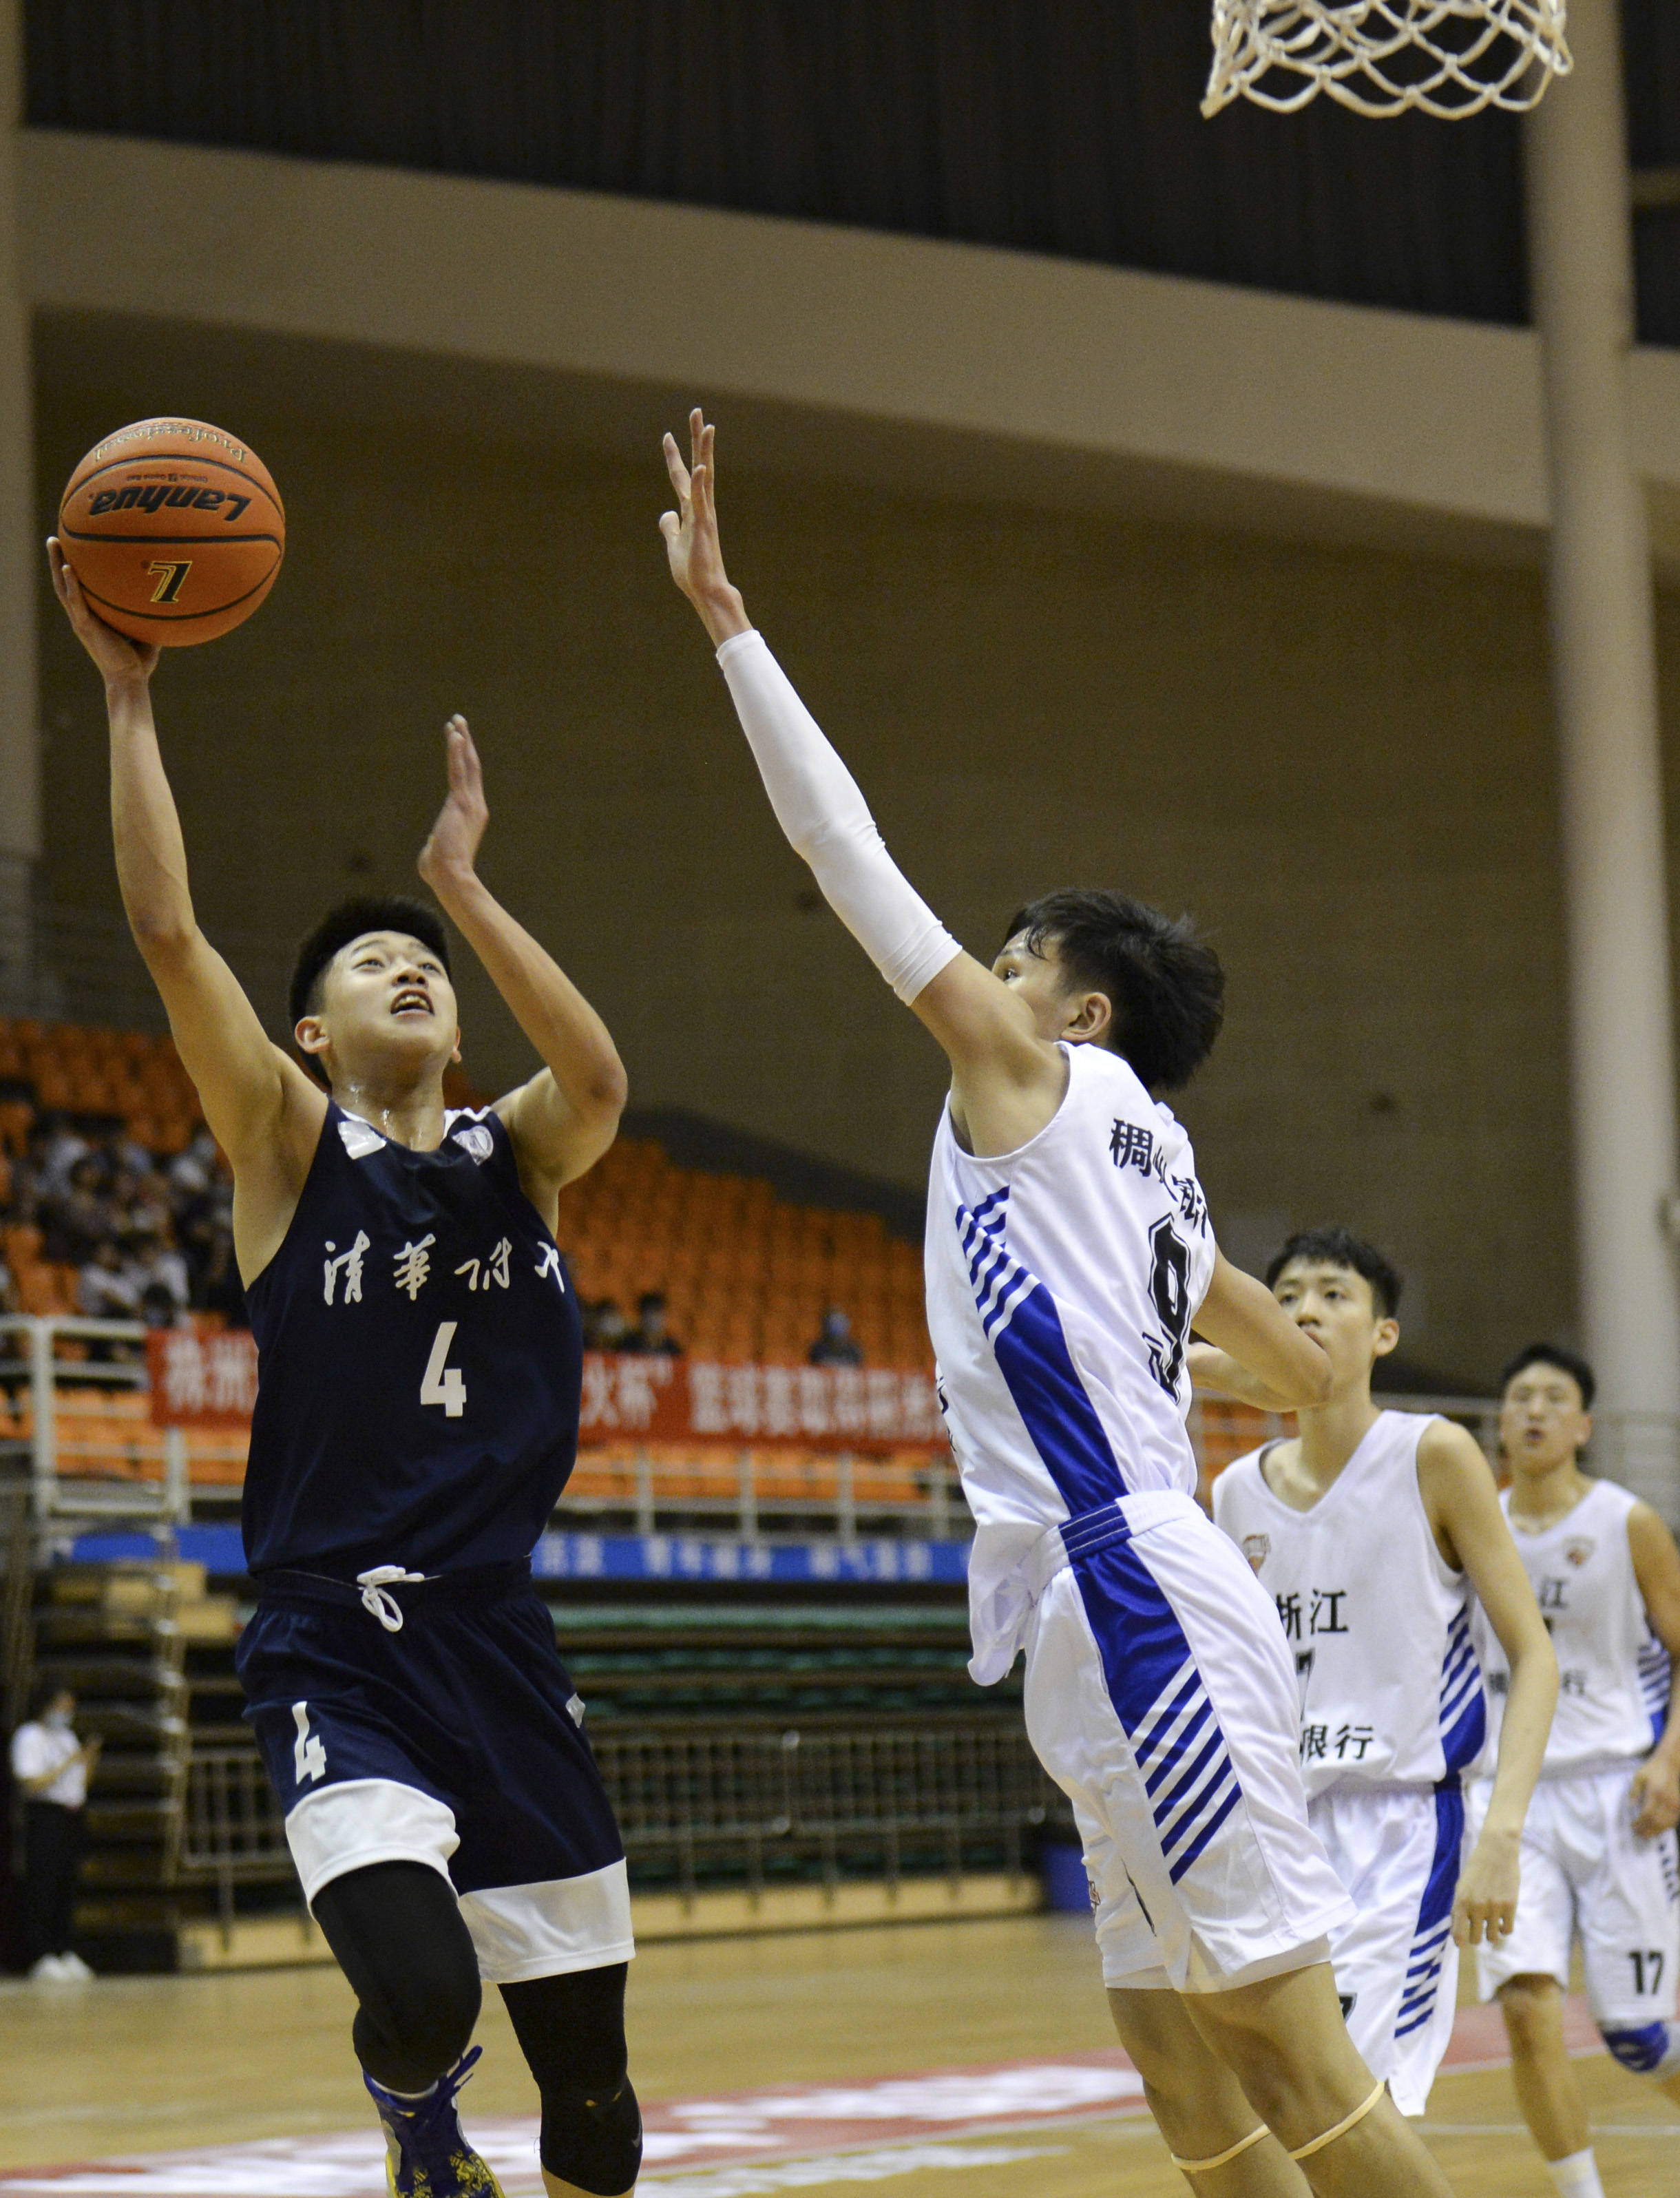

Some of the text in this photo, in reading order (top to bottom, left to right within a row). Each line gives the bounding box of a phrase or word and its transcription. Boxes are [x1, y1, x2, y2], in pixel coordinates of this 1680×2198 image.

[89, 485, 252, 522] Lanhua
[147, 560, 193, 605] 7
[420, 1321, 468, 1418] 4
[291, 1700, 328, 1786] 4
[1628, 1950, 1666, 1996] 17
